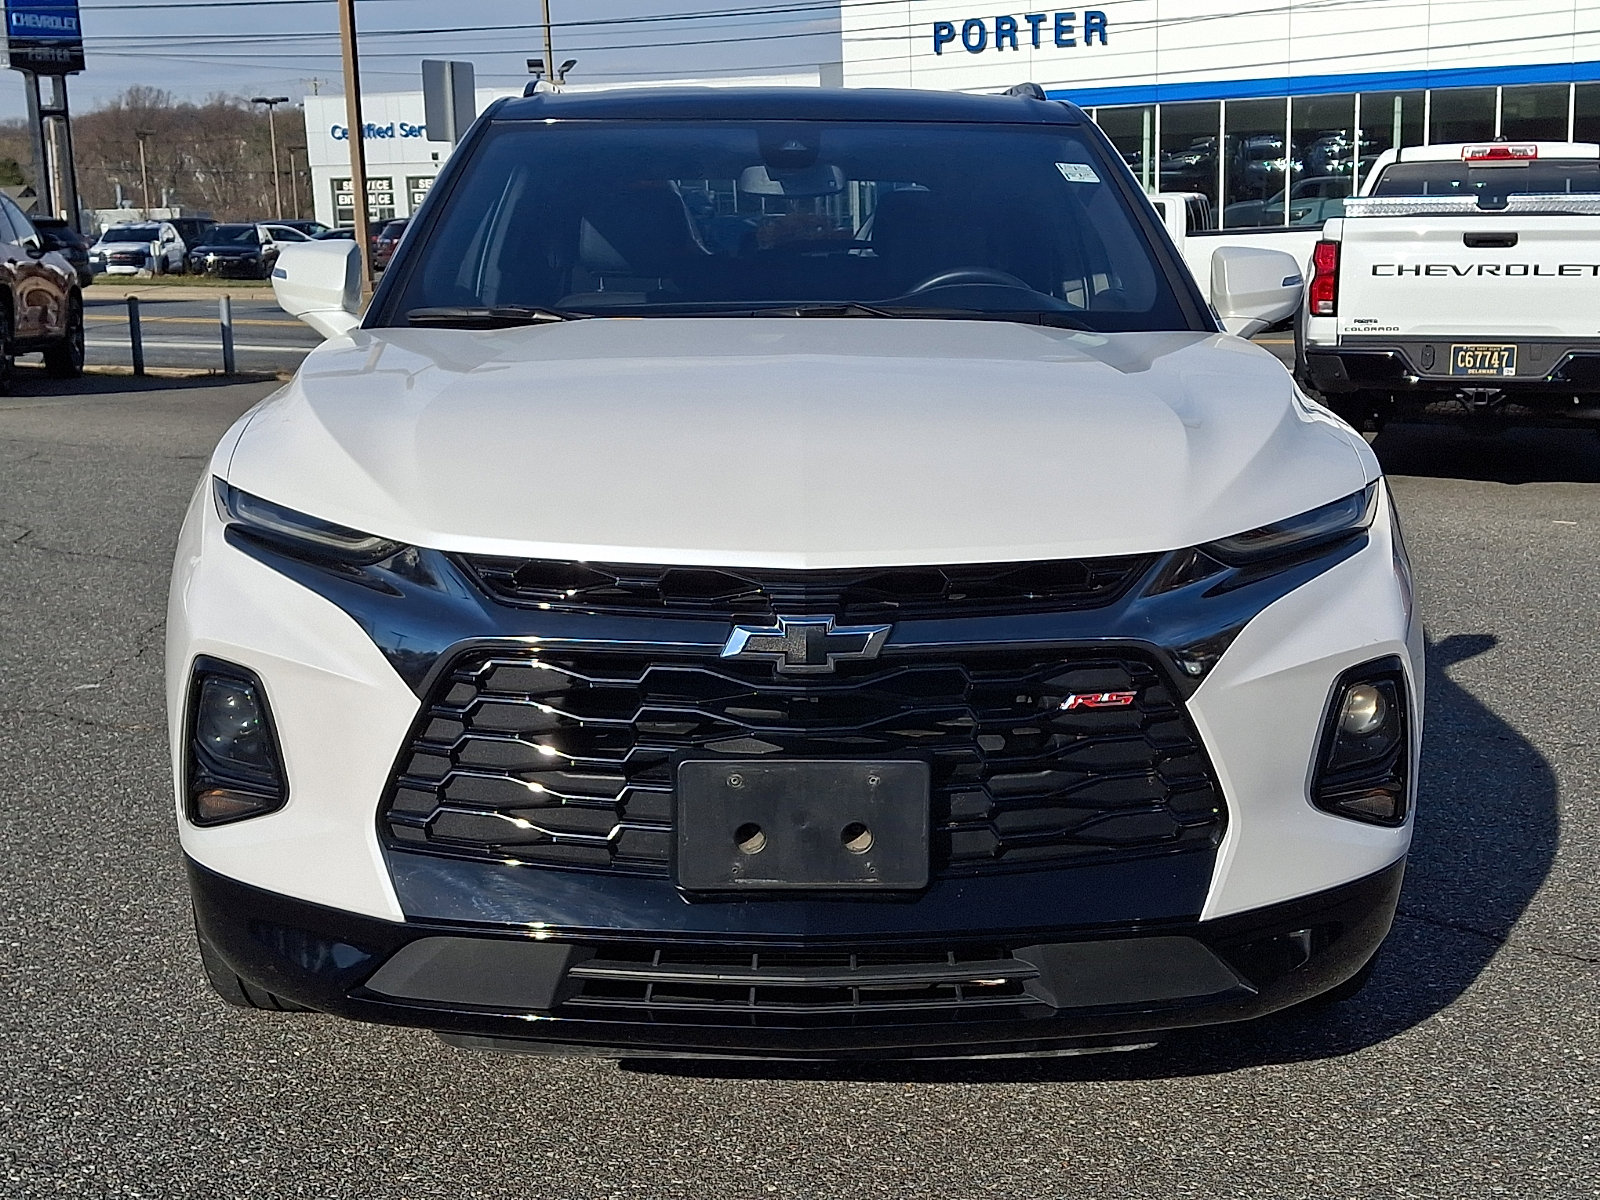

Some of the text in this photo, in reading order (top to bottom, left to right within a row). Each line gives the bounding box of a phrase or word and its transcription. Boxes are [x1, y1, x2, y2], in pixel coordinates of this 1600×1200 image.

[11, 12, 77, 30] CHEVROLET
[933, 10, 1108, 56] PORTER
[331, 122, 395, 140] Ceified
[342, 179, 390, 190] SEVICE
[1371, 263, 1600, 276] CHEVROLET
[1457, 351, 1509, 368] C67747
[1059, 691, 1137, 710] RS
